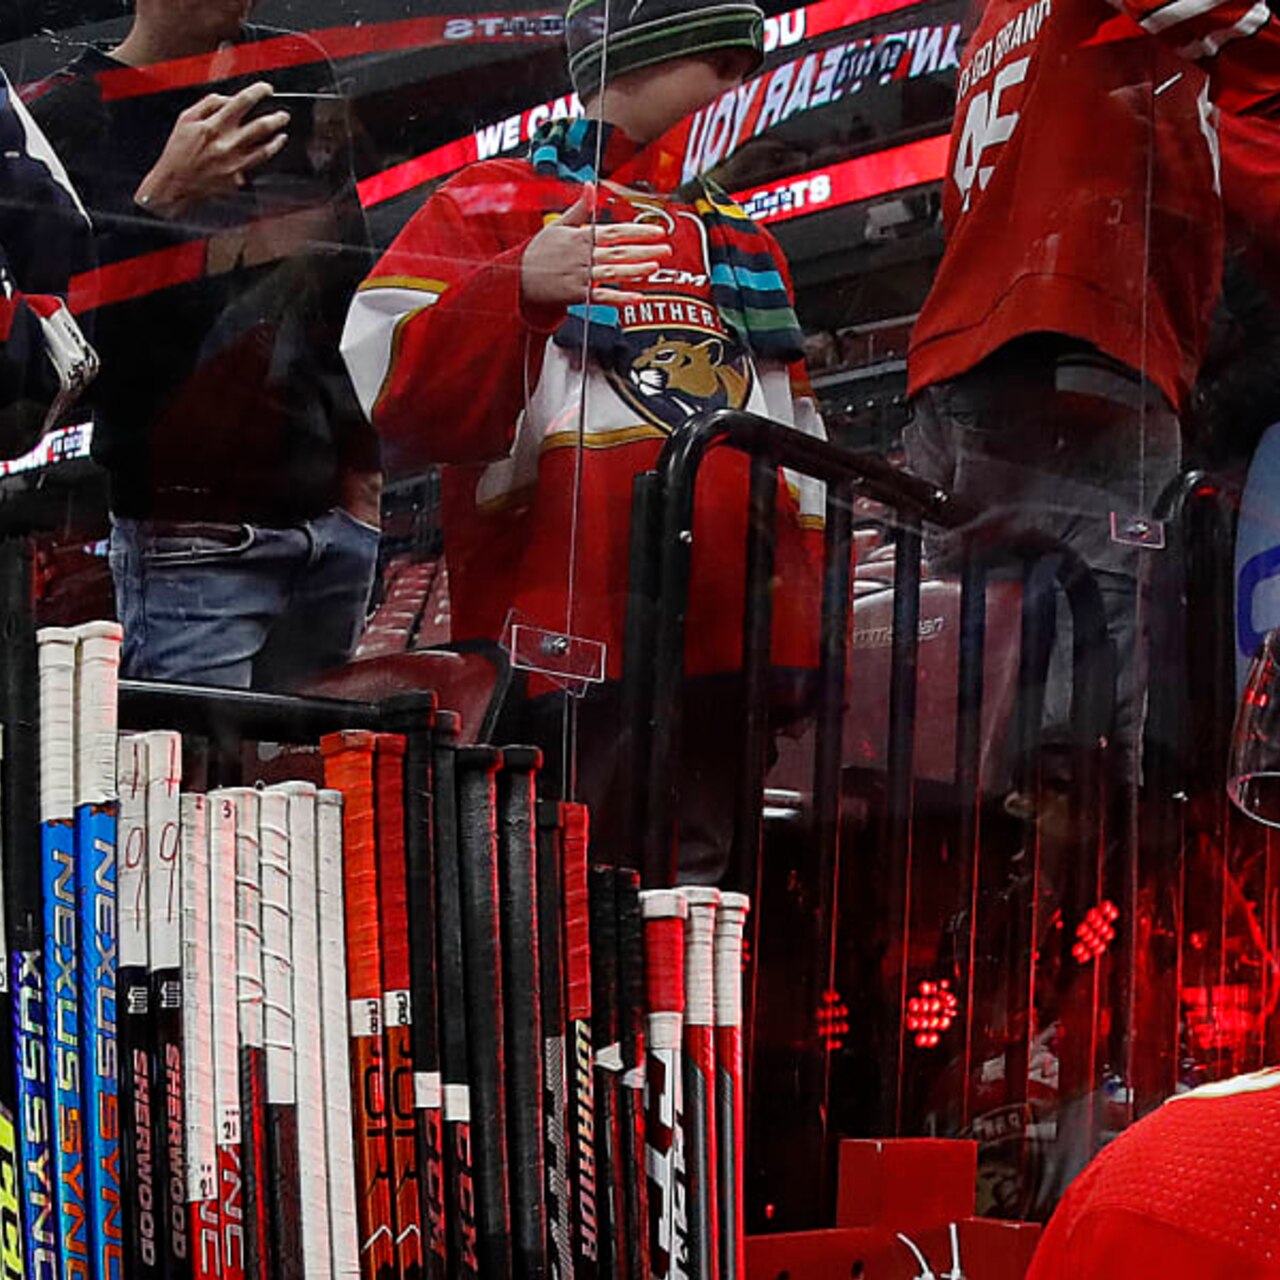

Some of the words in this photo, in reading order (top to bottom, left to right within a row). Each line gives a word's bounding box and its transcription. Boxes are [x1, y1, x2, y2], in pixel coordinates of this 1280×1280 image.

[623, 302, 730, 334] ANTHER
[632, 268, 708, 287] CM
[51, 850, 82, 1094] NEXUS
[92, 837, 119, 1081] NEXUS
[133, 1048, 157, 1267] SHERWOOD
[165, 1041, 188, 1260] SHERWOOD
[574, 1018, 599, 1263] WARRIOR
